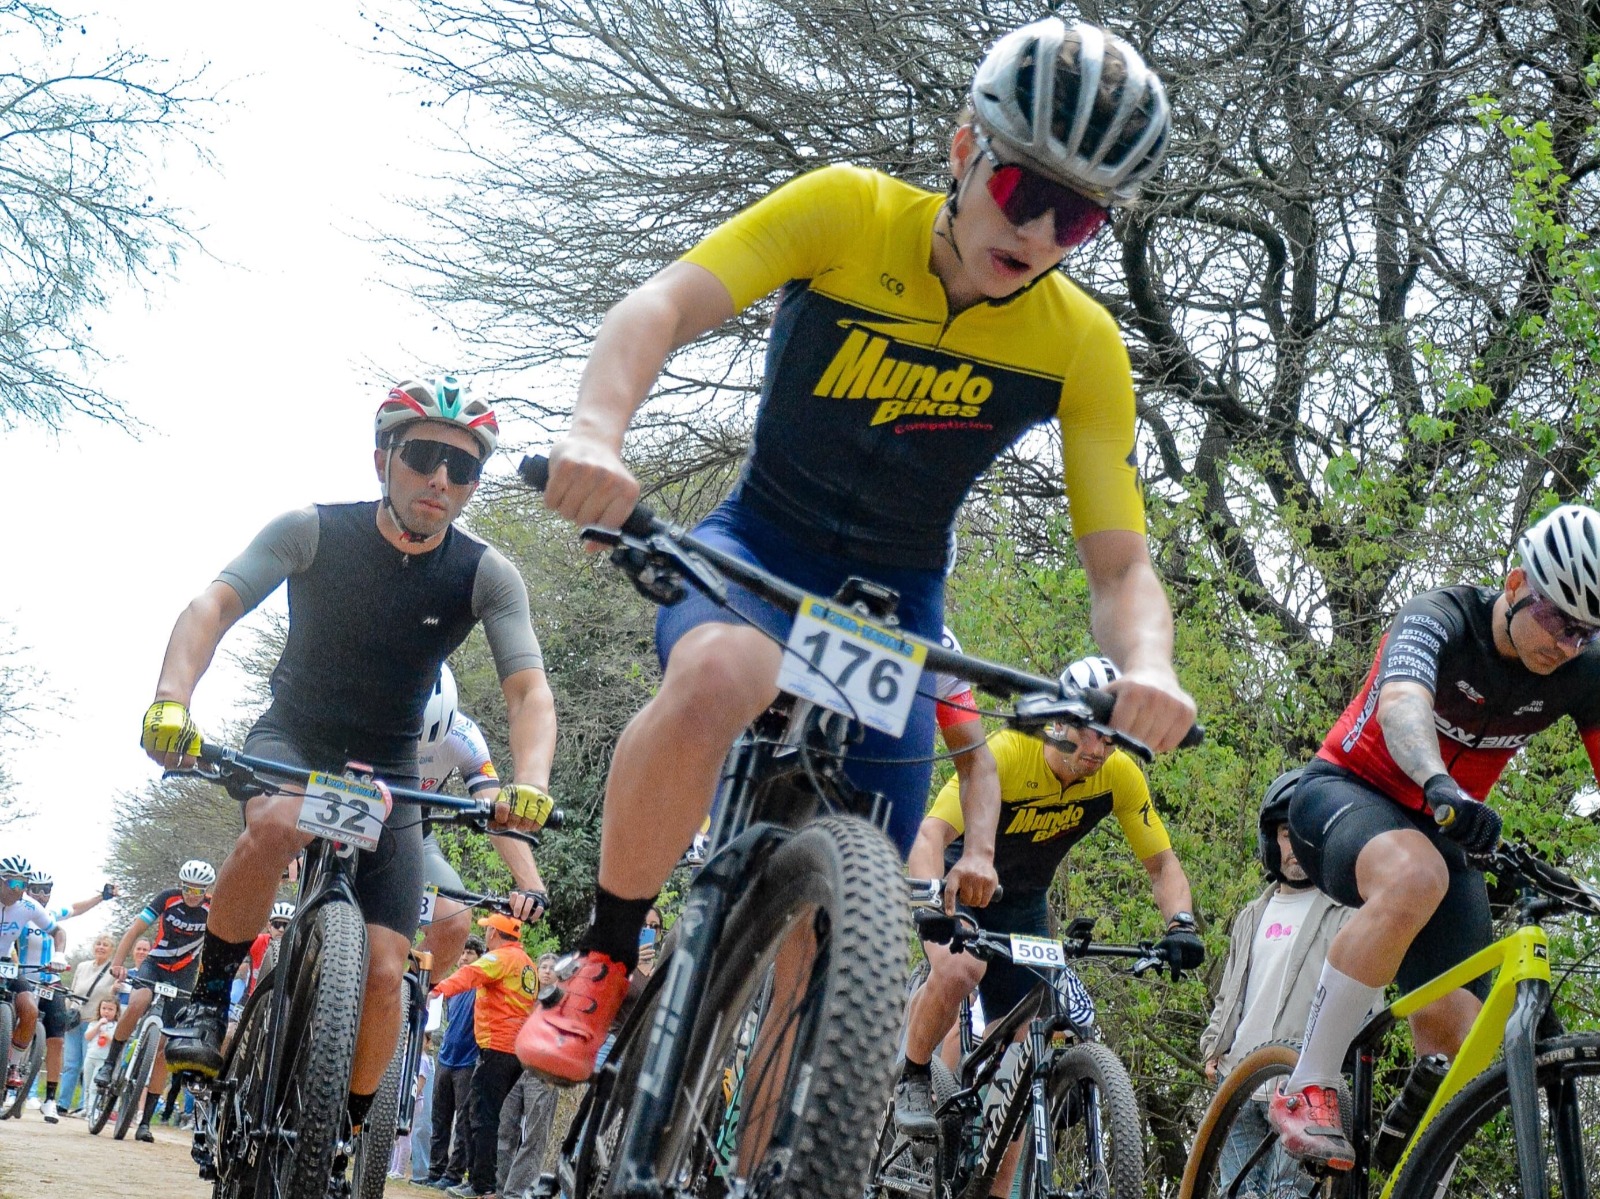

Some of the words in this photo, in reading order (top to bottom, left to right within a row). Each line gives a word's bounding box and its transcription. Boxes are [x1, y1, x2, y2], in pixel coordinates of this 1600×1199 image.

[813, 328, 993, 405] Mundo
[869, 399, 982, 426] Bikes
[803, 631, 904, 706] 176
[315, 791, 370, 834] 32
[1005, 804, 1084, 834] Mundo
[1018, 943, 1059, 961] 508
[0, 966, 15, 976] 71
[158, 985, 175, 995] 104
